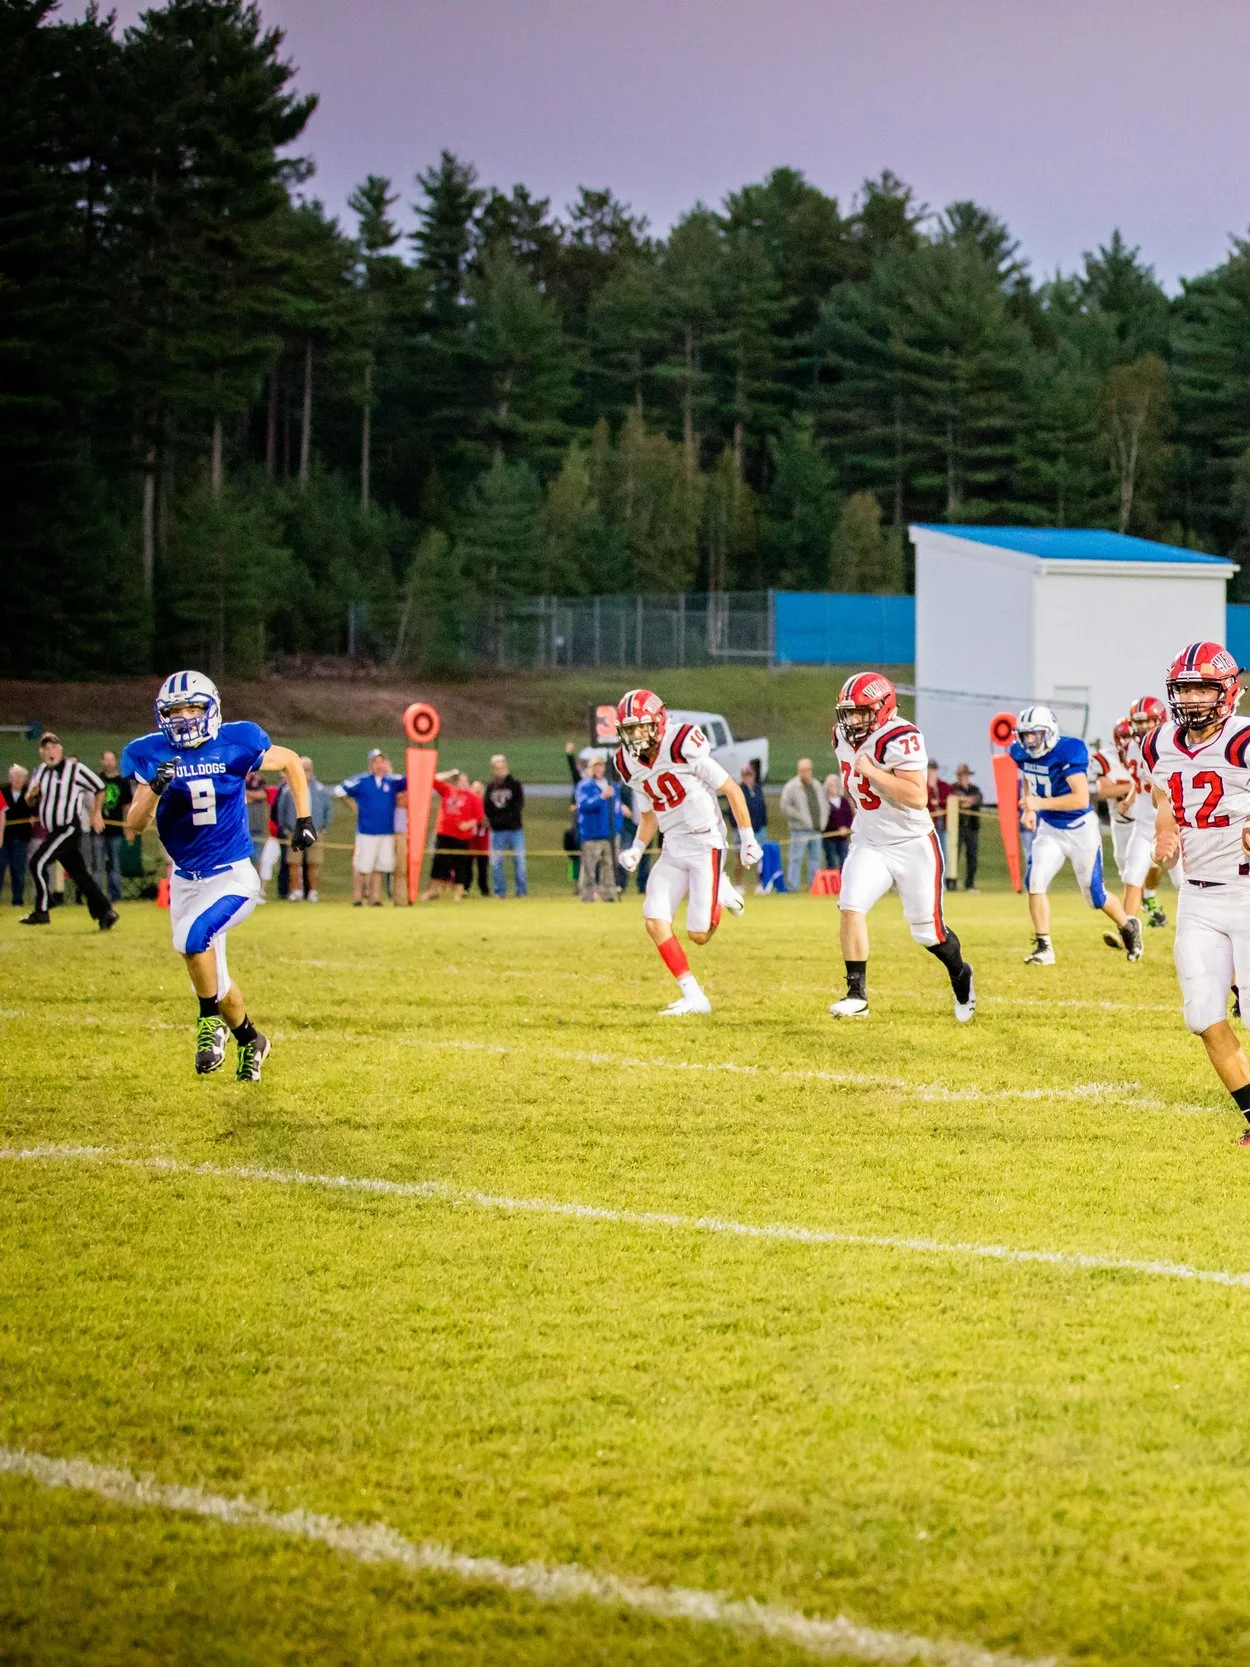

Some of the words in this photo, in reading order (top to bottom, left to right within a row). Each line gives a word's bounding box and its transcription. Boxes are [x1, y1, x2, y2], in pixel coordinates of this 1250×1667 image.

[596, 705, 618, 737] 3
[690, 729, 705, 748] 10
[899, 735, 921, 755] 73
[176, 763, 227, 777] ULLDOGS
[841, 761, 882, 811] 73
[186, 778, 218, 826] 9
[642, 771, 687, 812] 10
[1168, 771, 1230, 829] 12
[821, 875, 840, 895] 10
